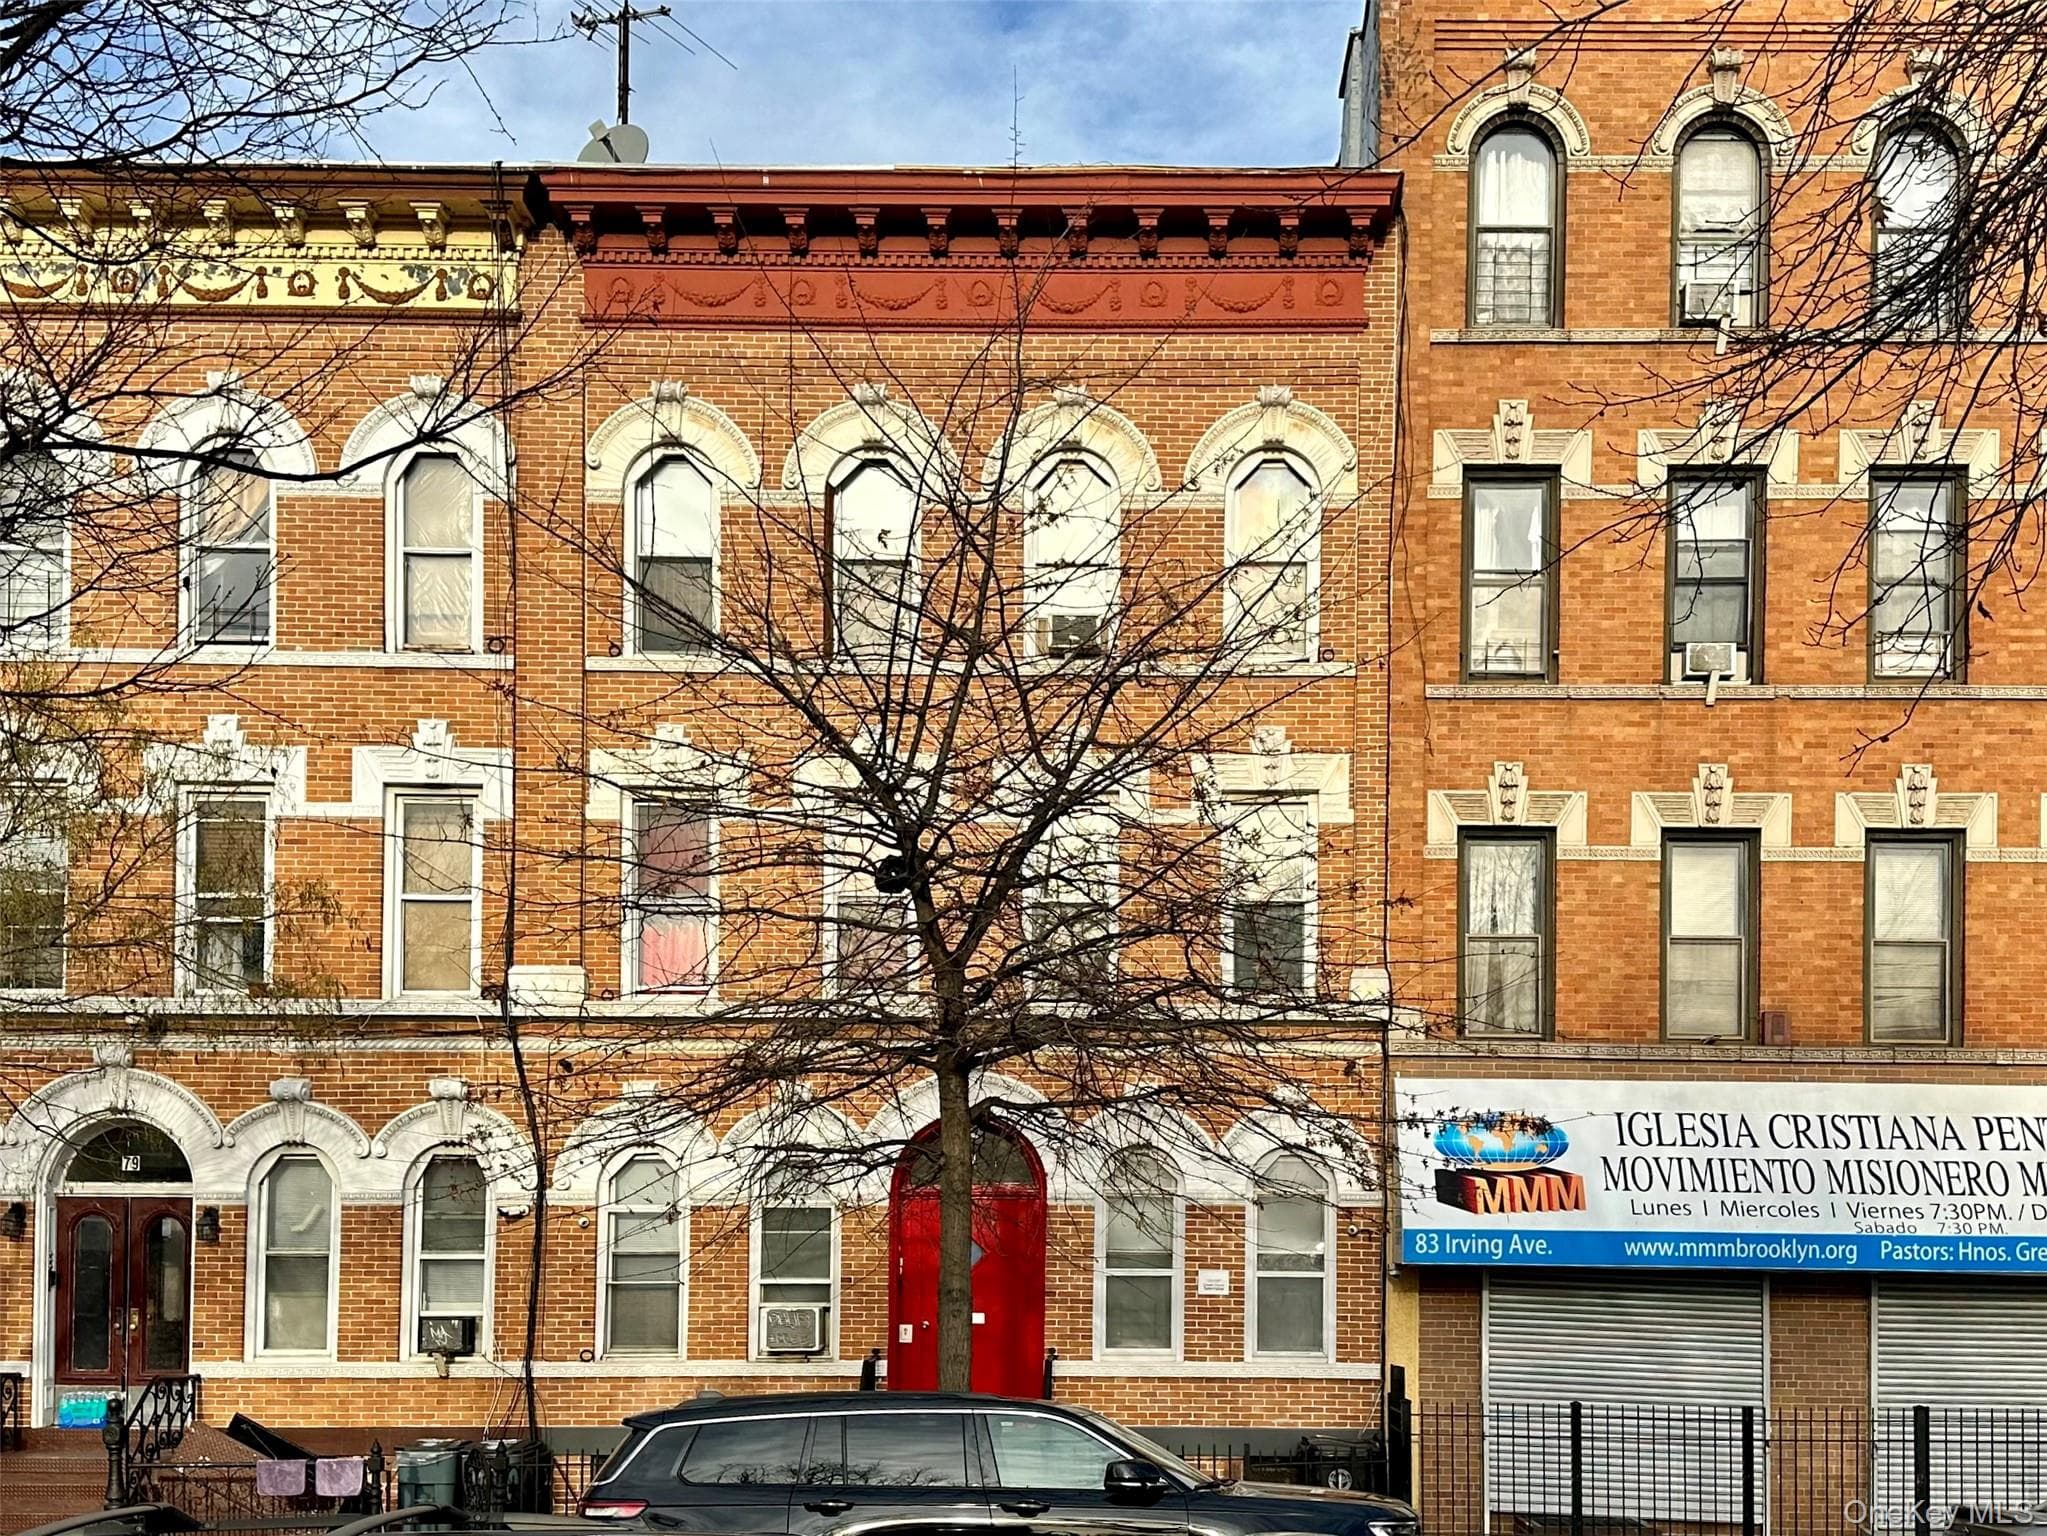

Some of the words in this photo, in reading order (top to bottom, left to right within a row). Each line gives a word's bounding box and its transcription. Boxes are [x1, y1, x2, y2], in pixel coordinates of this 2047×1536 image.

[1614, 1111, 1760, 1149] IGLESIA
[1768, 1113, 1967, 1151] CRISTIANA
[1972, 1116, 2047, 1152] PEN
[123, 1156, 139, 1170] 79
[1600, 1155, 1816, 1195] MOVIMIENTO
[1823, 1158, 2010, 1197] MISIONERO
[1475, 1175, 1587, 1215] MMM
[1630, 1199, 1692, 1216] Lunes
[1720, 1200, 1820, 1218] Miercoles
[1846, 1202, 1925, 1219] Viernes
[1929, 1203, 2013, 1220] 7:30PM.
[1854, 1221, 1918, 1234] Sabado
[1938, 1222, 1973, 1235] 7:30
[1979, 1223, 2009, 1235] PM.
[1415, 1233, 1439, 1254] 83
[1446, 1233, 1503, 1260] Irving
[1509, 1233, 1553, 1255] Ave.
[1624, 1237, 1857, 1264] www.mmmbrooklyn.org
[1881, 1240, 1954, 1261] Pastors:
[1959, 1241, 2012, 1262] Hnos.
